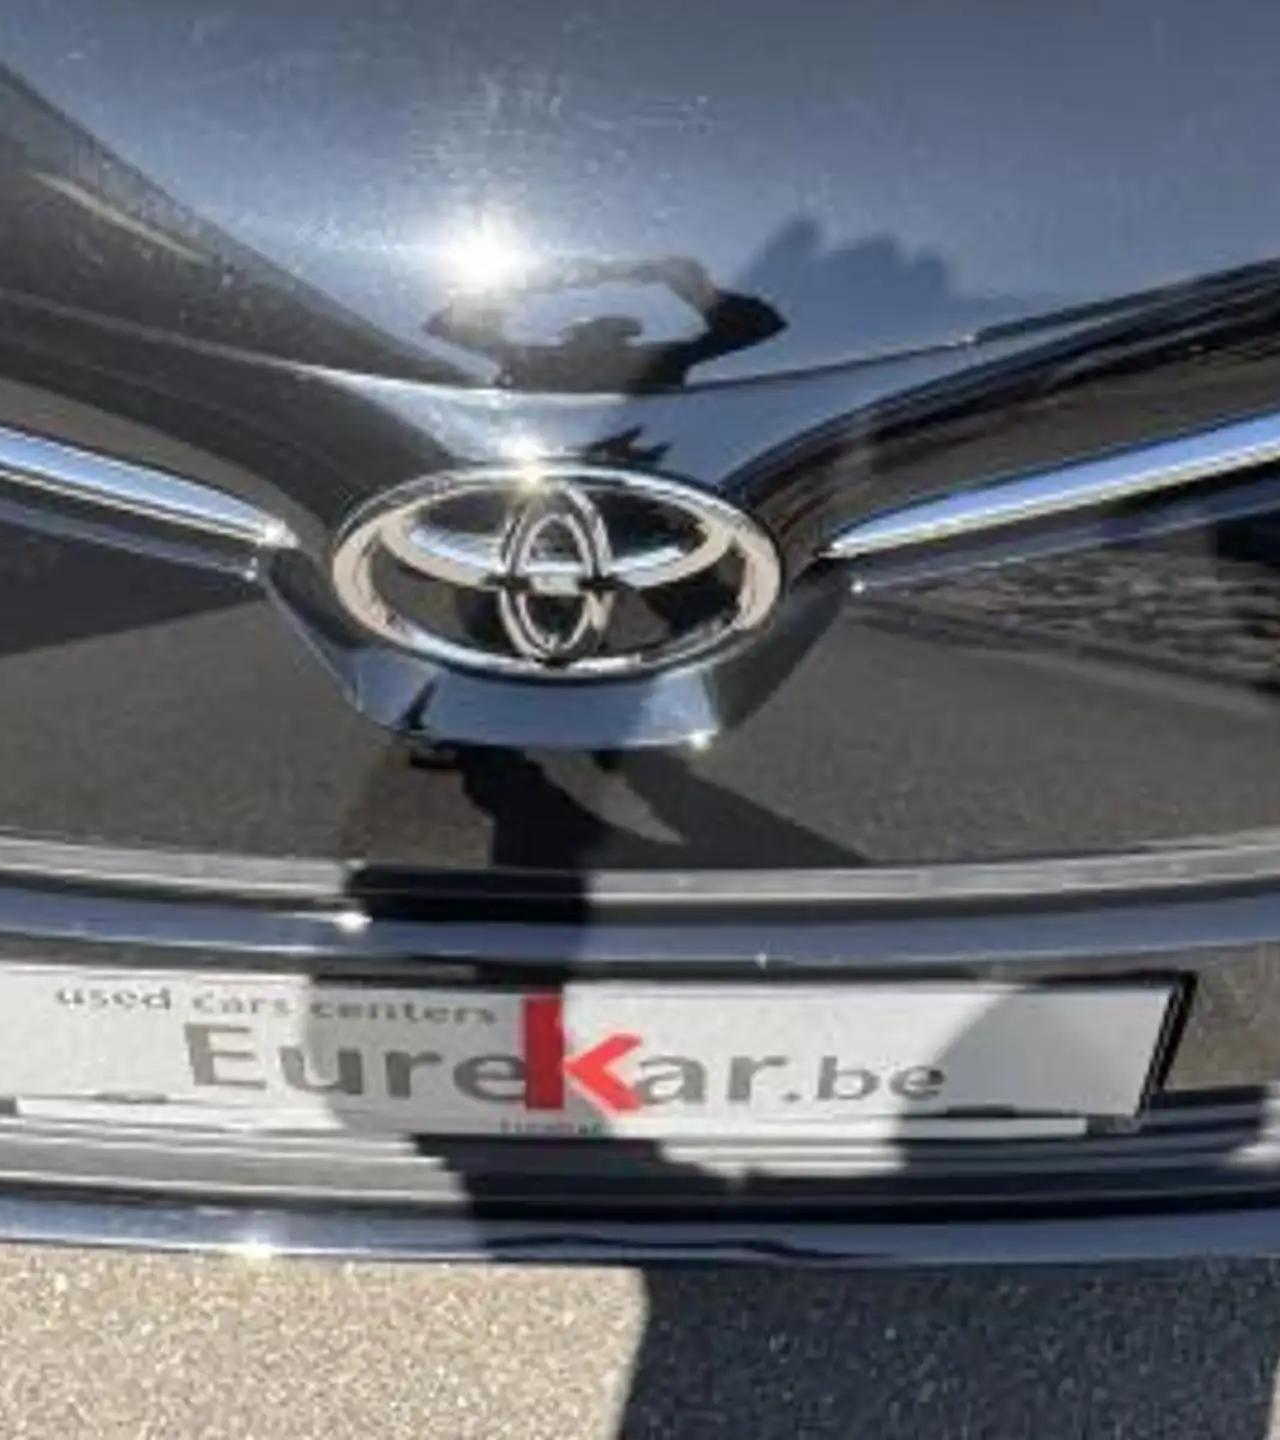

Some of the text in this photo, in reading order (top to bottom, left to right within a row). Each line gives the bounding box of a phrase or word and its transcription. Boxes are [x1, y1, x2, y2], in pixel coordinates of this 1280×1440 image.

[55, 987, 497, 1025] used cars centers
